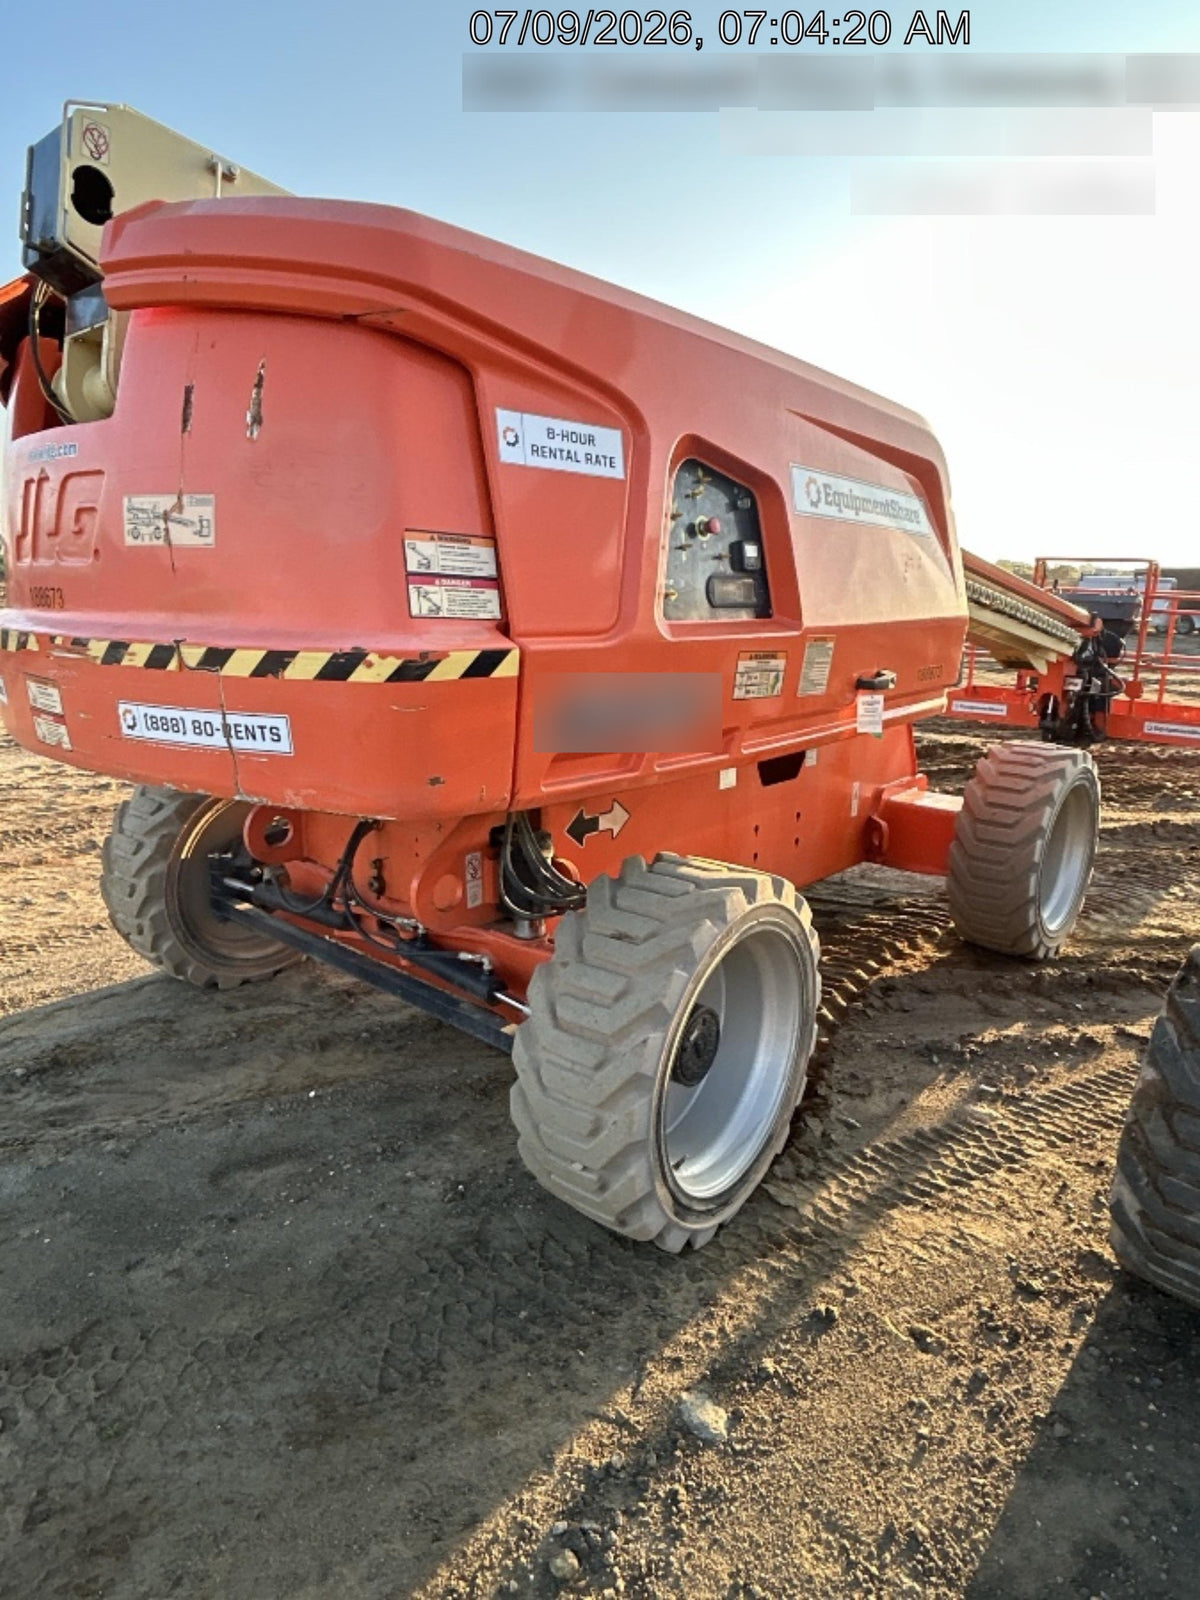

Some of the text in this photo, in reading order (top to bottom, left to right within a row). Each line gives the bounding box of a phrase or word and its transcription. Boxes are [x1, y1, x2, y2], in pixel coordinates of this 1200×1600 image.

[530, 444, 617, 469] RENTAL RATE
[822, 482, 921, 525] EquipmentShare
[143, 712, 187, 736] (888)
